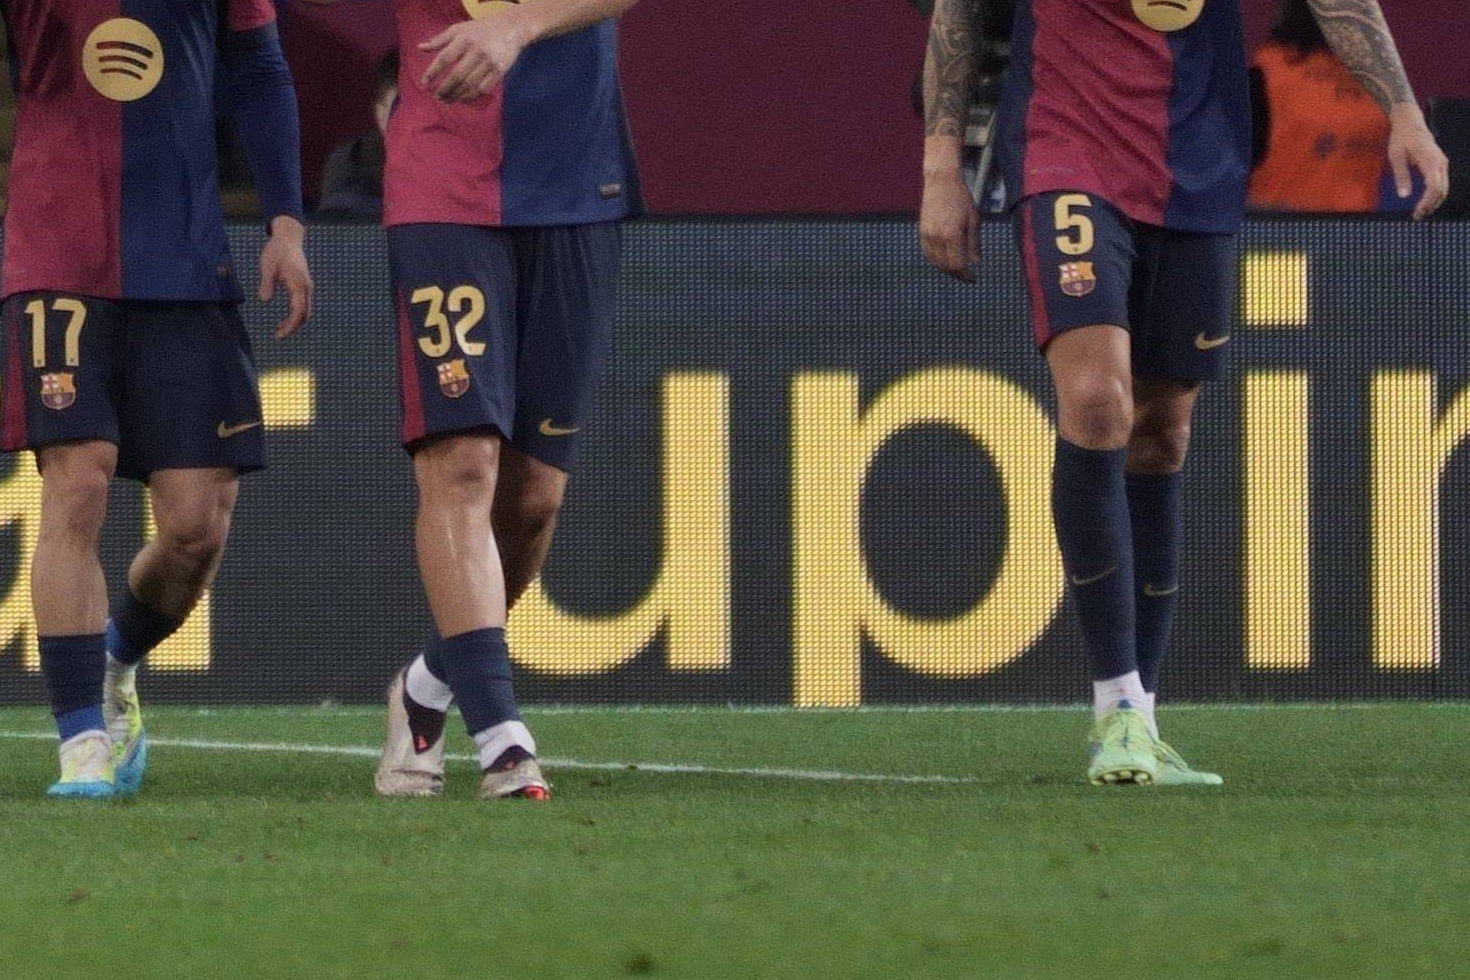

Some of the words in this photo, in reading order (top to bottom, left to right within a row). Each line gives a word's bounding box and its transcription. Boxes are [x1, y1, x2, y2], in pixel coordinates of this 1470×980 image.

[1054, 194, 1094, 255] 5
[24, 298, 87, 368] 17
[412, 285, 486, 357] 32
[506, 365, 1066, 708] up
